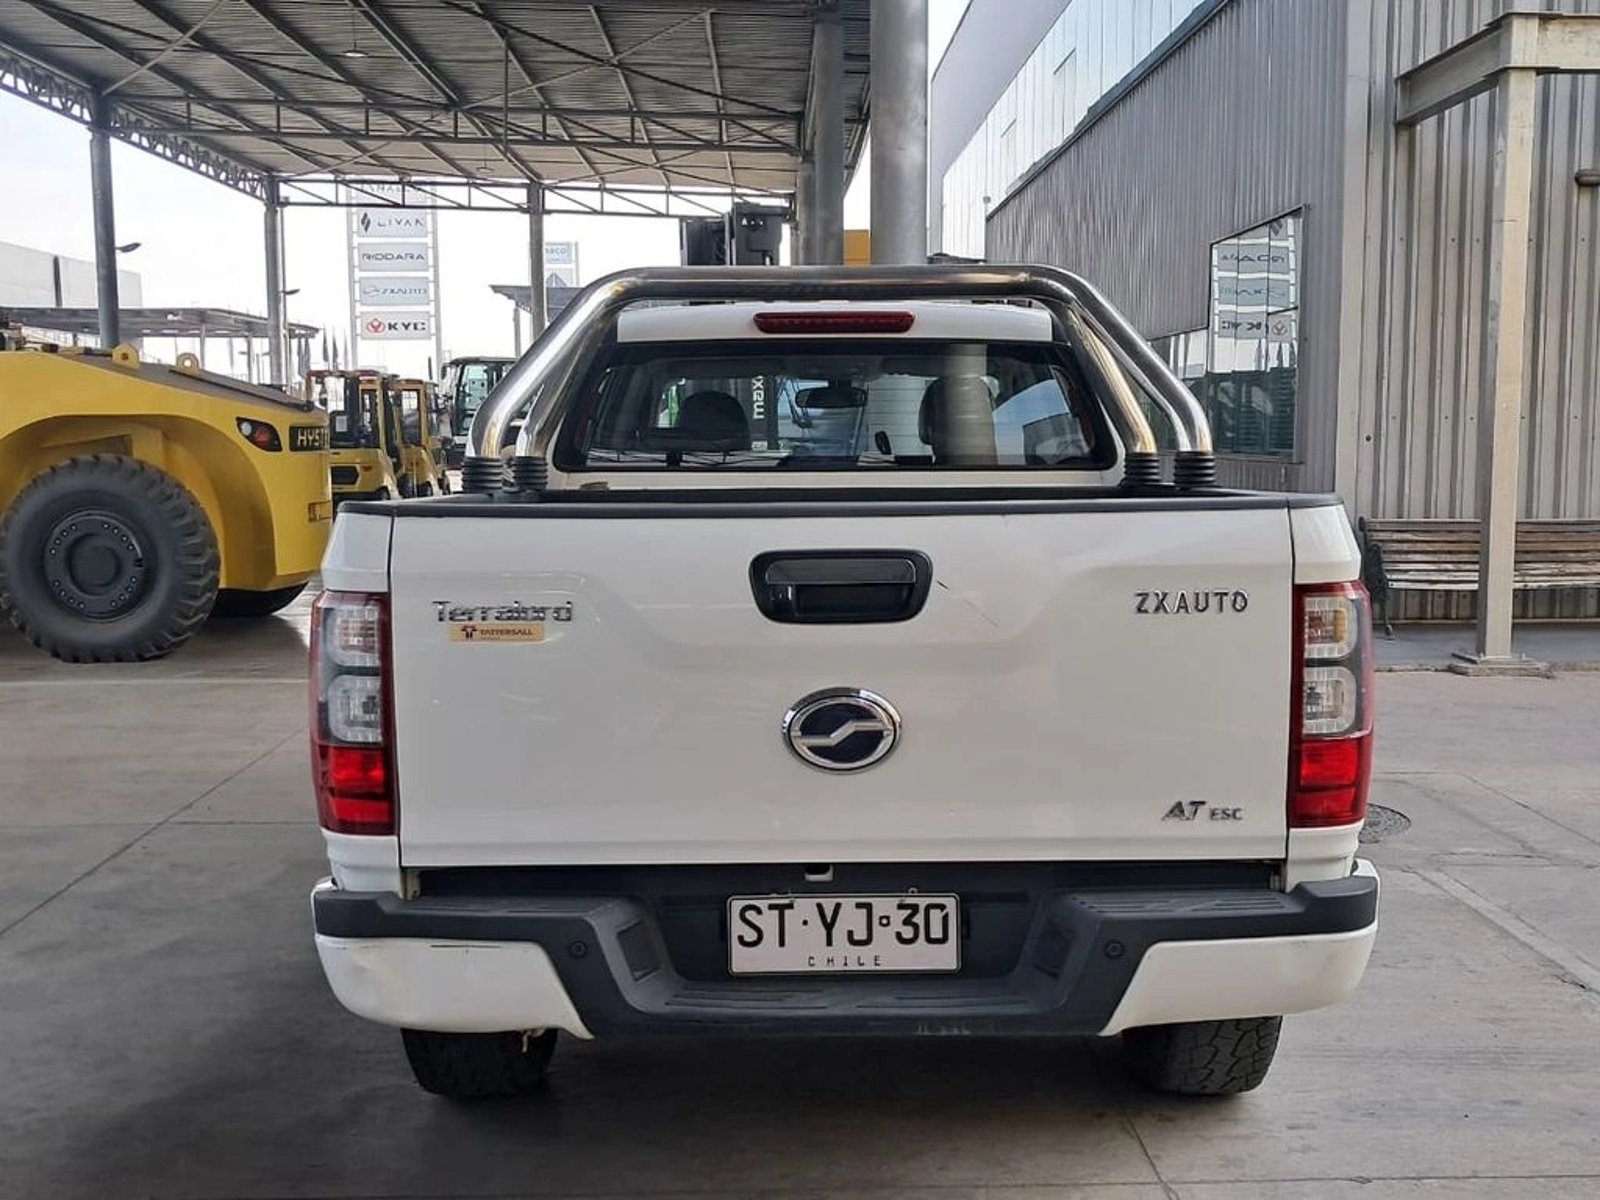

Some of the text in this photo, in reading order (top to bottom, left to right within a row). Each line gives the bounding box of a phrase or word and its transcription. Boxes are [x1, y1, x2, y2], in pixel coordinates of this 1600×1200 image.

[1135, 589, 1249, 615] ZXAUTO
[1161, 800, 1243, 821] AT ESC
[807, 955, 882, 967] CHILE
